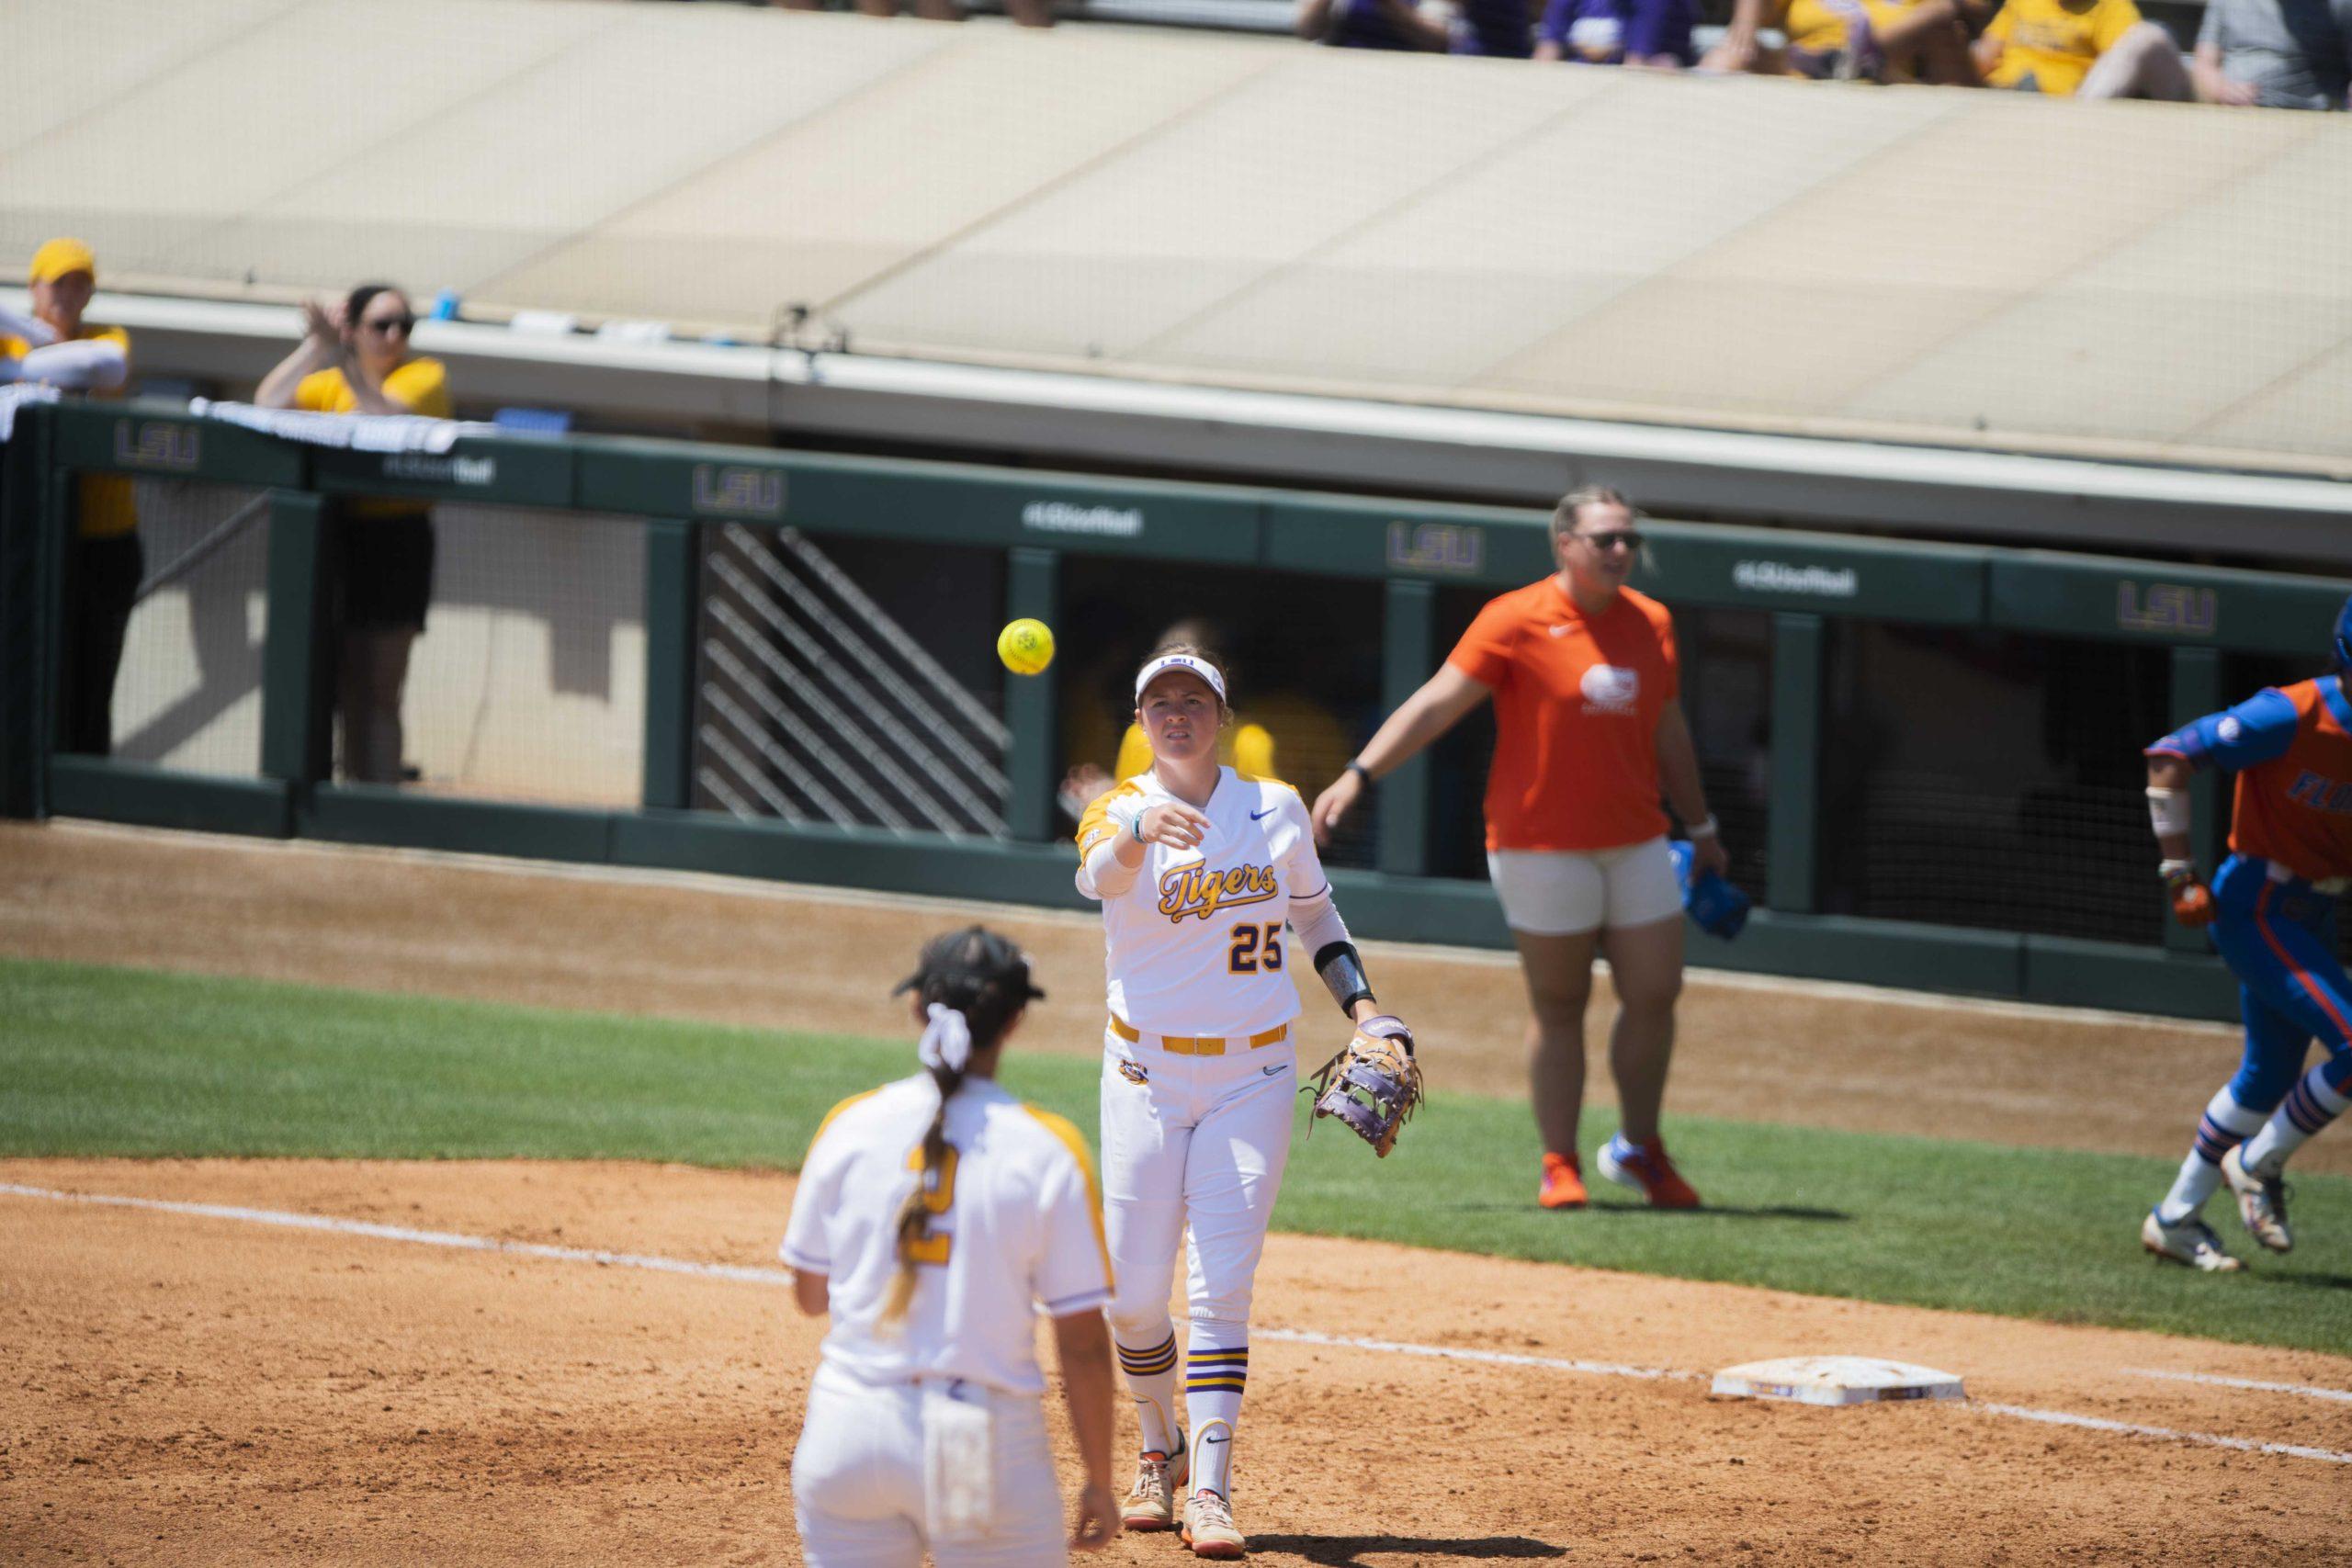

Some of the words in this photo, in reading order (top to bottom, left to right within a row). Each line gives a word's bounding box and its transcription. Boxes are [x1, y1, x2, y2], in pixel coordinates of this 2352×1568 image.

[114, 419, 201, 470] LSU
[693, 464, 787, 517] LSU
[1385, 521, 1486, 574] LSU
[2117, 581, 2217, 636] LSU
[1159, 858, 1278, 923] Tigers
[1227, 921, 1283, 976] 25
[897, 1143, 960, 1267] 2
